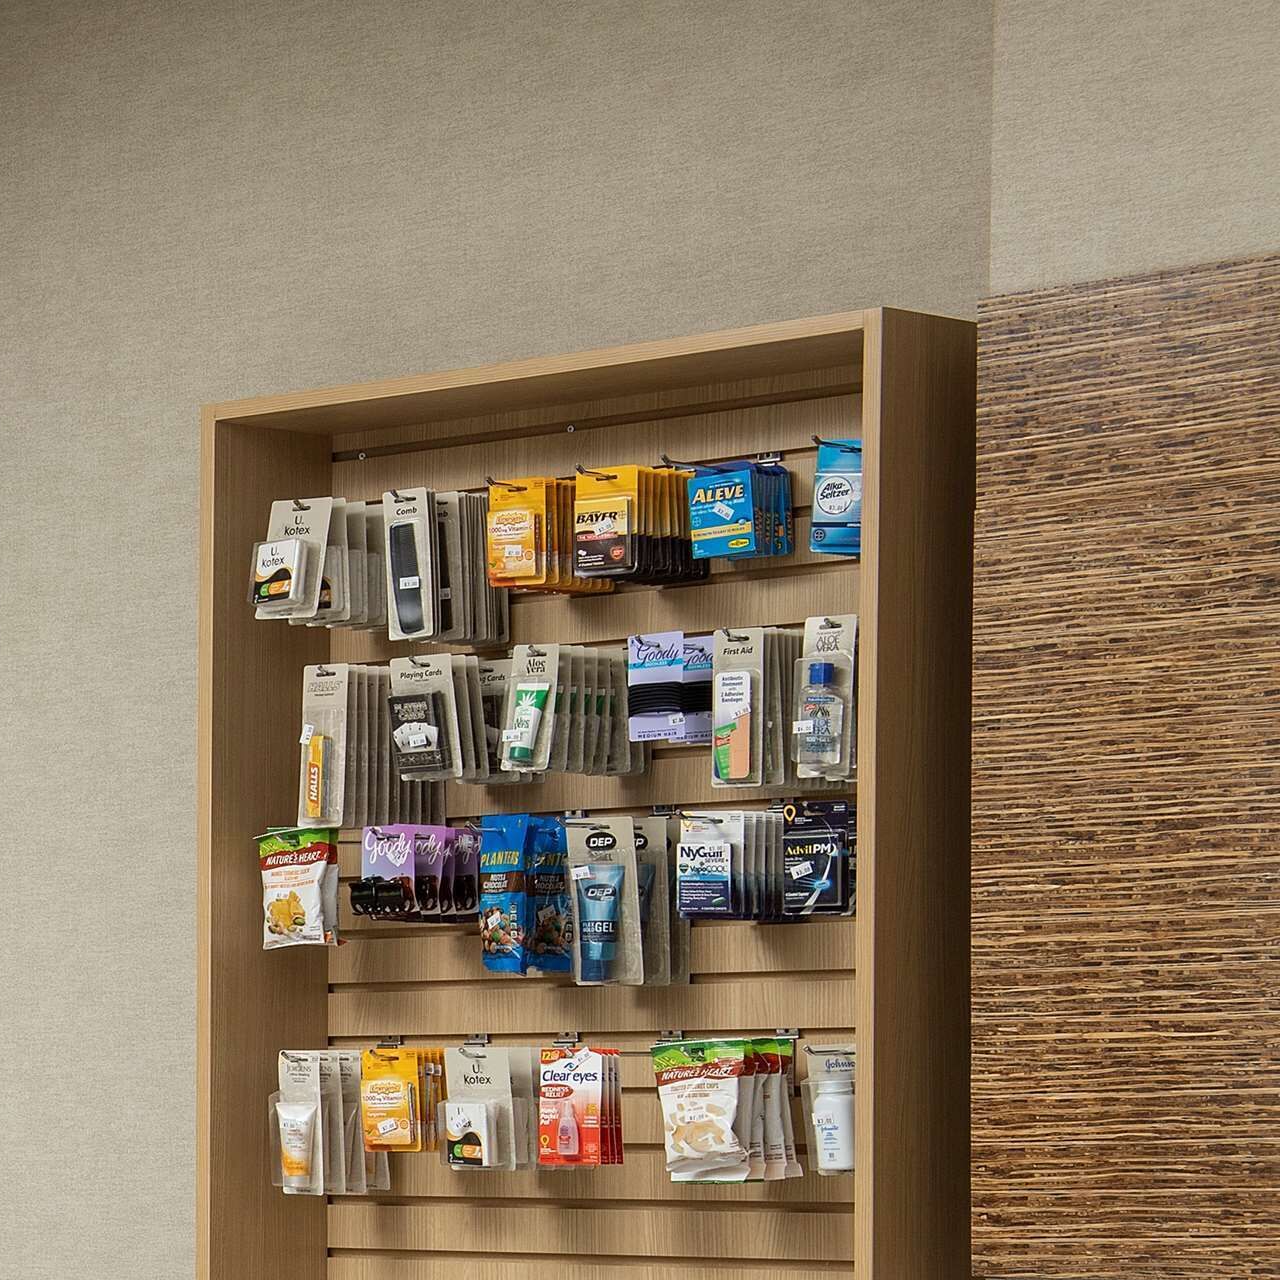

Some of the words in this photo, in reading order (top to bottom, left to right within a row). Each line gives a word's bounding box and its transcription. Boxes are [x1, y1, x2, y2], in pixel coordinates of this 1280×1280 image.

[823, 482, 846, 492] Alka-
[692, 484, 745, 504] ALEVE
[819, 489, 851, 501] Seltzer
[396, 506, 418, 517] Comb
[294, 515, 305, 526] U.
[576, 511, 617, 525] BAYER
[284, 525, 310, 537] kotex
[270, 547, 280, 557] U.
[261, 556, 285, 568] kotex
[817, 635, 840, 644] ALOE
[636, 642, 680, 664] Goody
[723, 647, 740, 656] First
[740, 646, 753, 655] Aid
[815, 642, 840, 652] VERA
[527, 658, 546, 667] Aloe
[400, 670, 424, 680] Playing
[424, 668, 443, 677] Cards
[525, 665, 546, 674] Vera
[485, 673, 506, 682] Cards
[393, 701, 428, 713] PLAYING
[308, 767, 318, 801] HALLS
[364, 827, 412, 865] Goody
[589, 837, 614, 847] DEP
[785, 844, 812, 856] Advil
[811, 843, 832, 854] PM
[266, 851, 298, 866] NATURE'S
[298, 850, 321, 863] HEART
[480, 851, 520, 867] PLANTERS
[587, 888, 613, 898] DEP
[594, 920, 615, 933] GEL
[472, 1064, 483, 1074] U.
[706, 1065, 735, 1077] HEART
[464, 1074, 492, 1085] kotex
[542, 1069, 572, 1083] Clear
[571, 1071, 598, 1086] eyes
